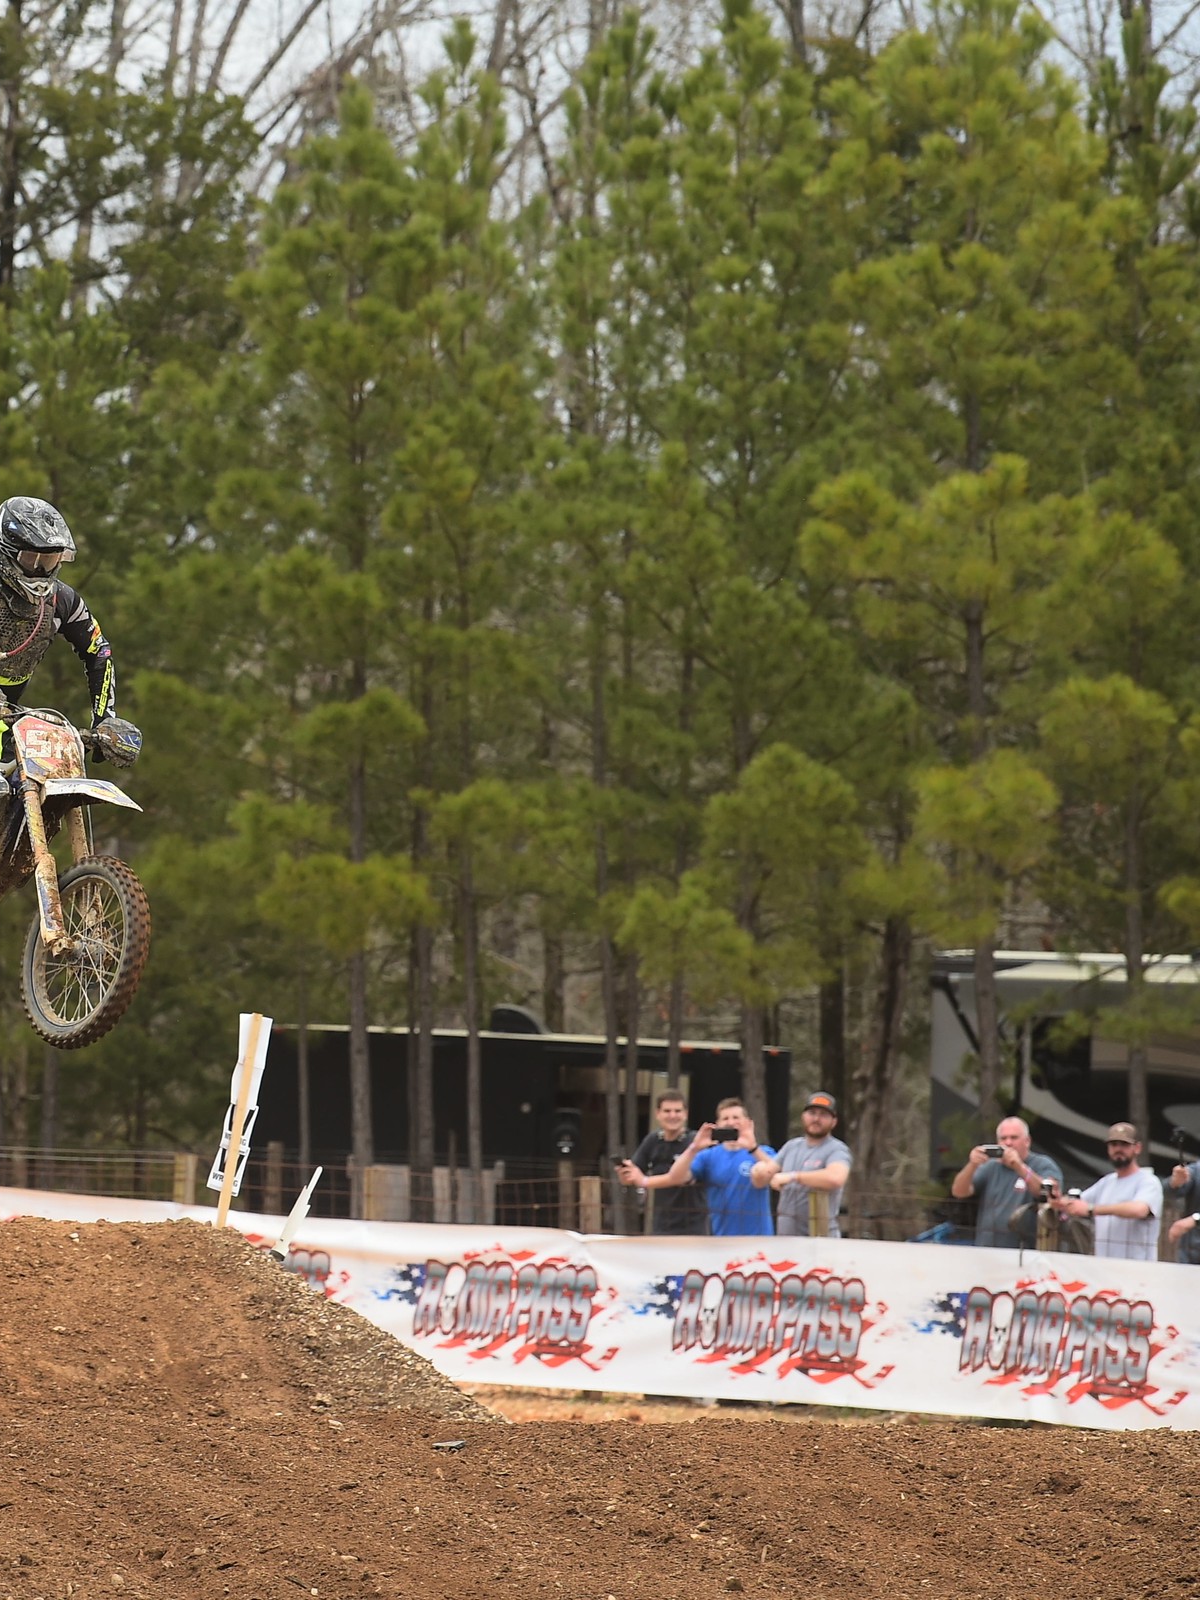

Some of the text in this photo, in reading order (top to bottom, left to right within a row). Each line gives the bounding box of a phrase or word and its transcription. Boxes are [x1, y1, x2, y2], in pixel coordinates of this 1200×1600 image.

[224, 1131, 247, 1147] WRG
[212, 1172, 238, 1188] WRG
[508, 1263, 597, 1344] PASS
[772, 1274, 866, 1361] PASS
[1058, 1295, 1154, 1386] PASS
